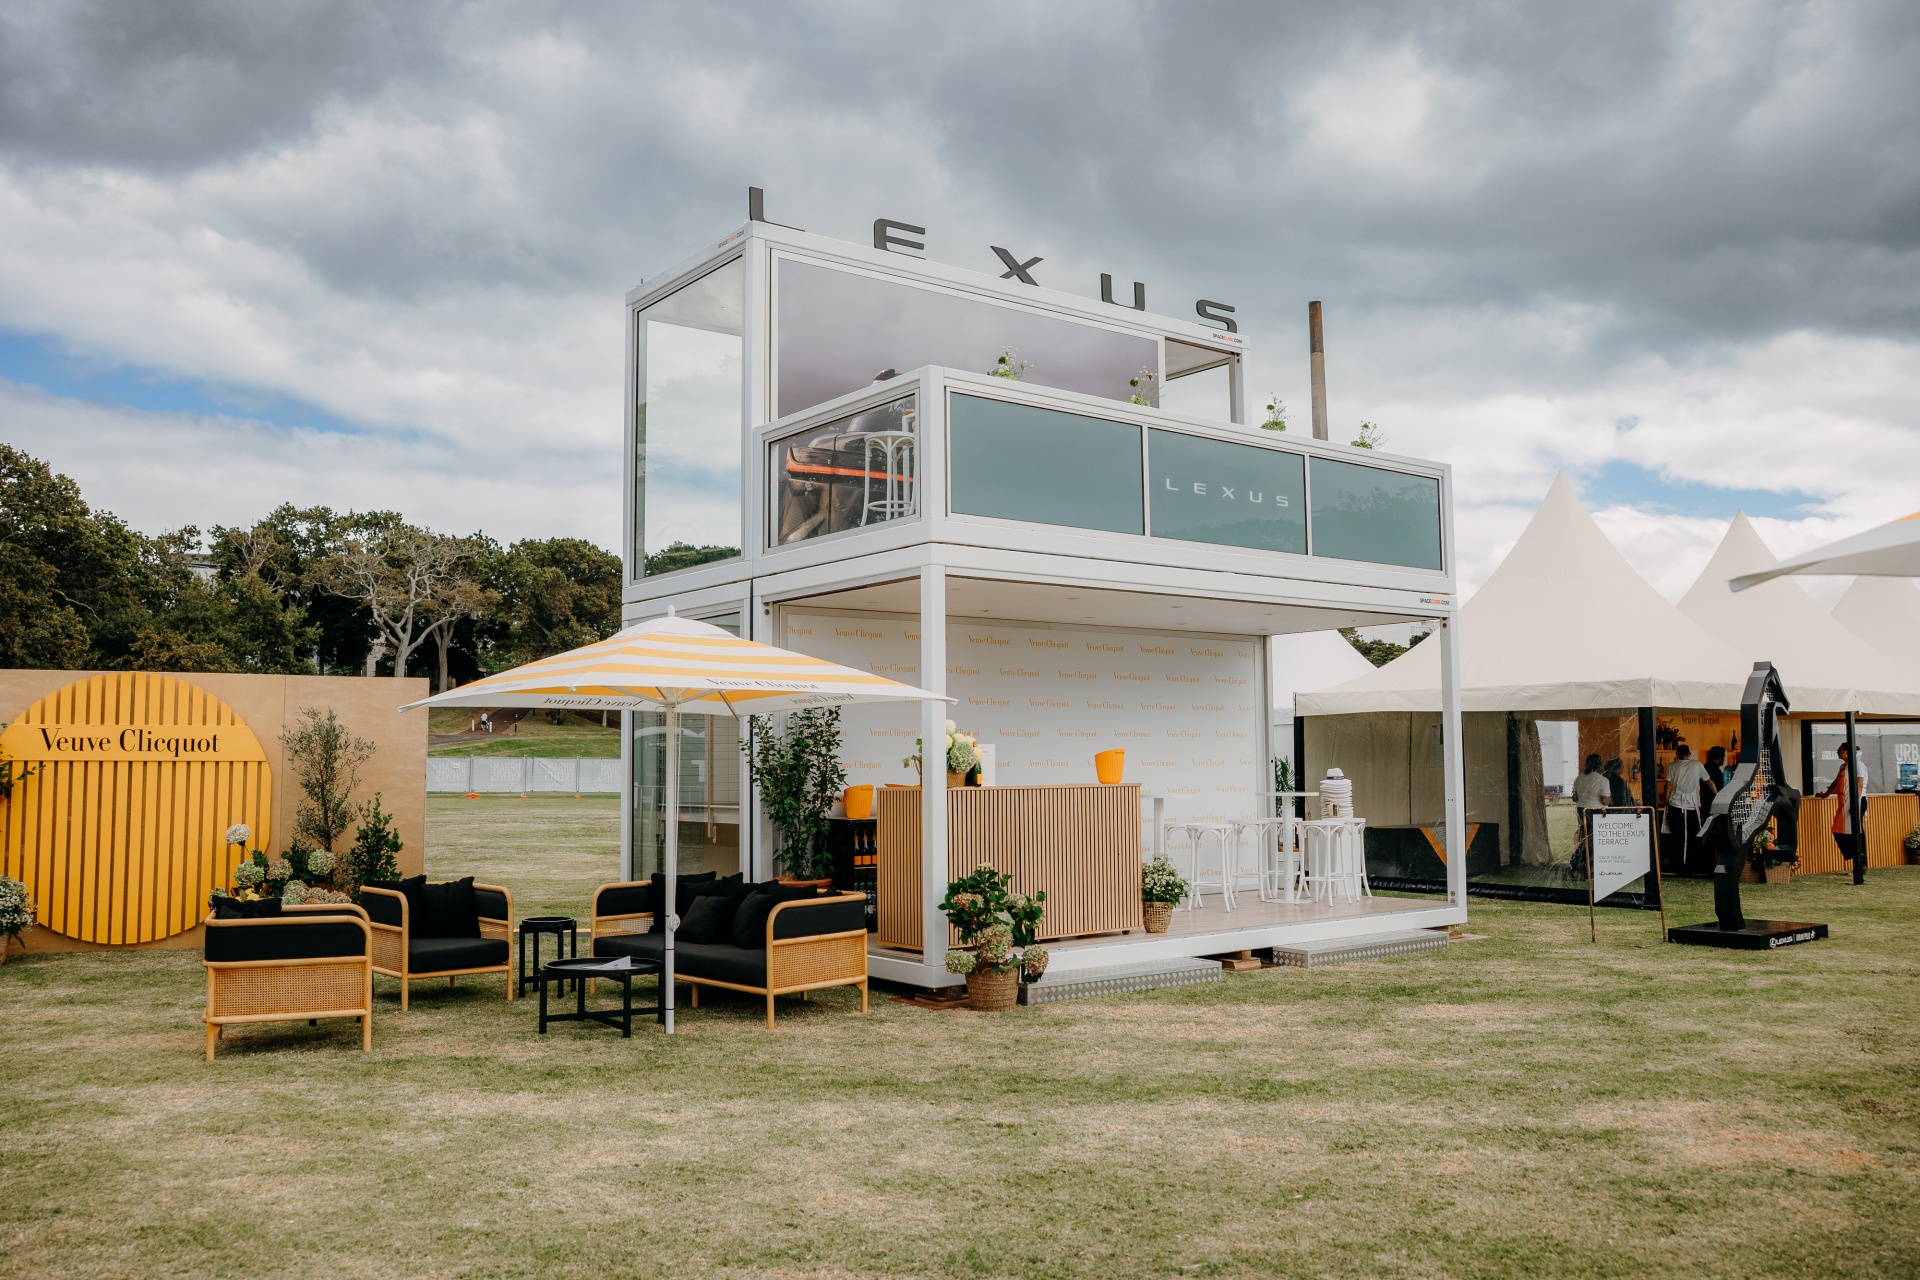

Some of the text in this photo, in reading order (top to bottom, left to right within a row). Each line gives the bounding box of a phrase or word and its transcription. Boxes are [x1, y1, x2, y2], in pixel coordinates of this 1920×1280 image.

[749, 186, 1238, 333] LEXUS
[1166, 478, 1289, 508] LEXUS
[788, 626, 812, 636] licquot
[835, 628, 883, 639] Veuve Clicquot
[968, 635, 1010, 646] Veuve Clicquot
[1029, 638, 1069, 649] Veuve Clicquot
[1103, 644, 1123, 653] Clicquot
[1155, 647, 1174, 655] Clicquot
[1191, 648, 1223, 658] Veuve Clicquot
[870, 662, 916, 673] Veuve Clicquot
[956, 666, 980, 676] Clicquot
[1000, 668, 1040, 678] Veuve Clicquot
[1058, 670, 1096, 680] Veuve Clicquot
[1114, 672, 1150, 682] Veuve Clicquot
[706, 678, 820, 690] Veuve Clicquot
[1180, 675, 1200, 684] Clicquot
[1229, 676, 1247, 686] Clicquot
[968, 697, 1010, 707] Veuve Clicquot
[1029, 699, 1069, 708] Veuve Clicquot
[1103, 702, 1124, 710] Clicquot
[1156, 702, 1176, 711] Clicquot
[1206, 704, 1224, 712] Clicquot
[1682, 714, 1720, 727] Veuve Clicquot
[870, 728, 916, 738] Veuve Clicquot
[1017, 730, 1040, 738] Clicquot
[1075, 730, 1096, 738] Clicquot
[1130, 730, 1150, 739] Clicquot
[1181, 731, 1200, 739] Clicquot
[38, 728, 221, 757] Veuve Clicquot
